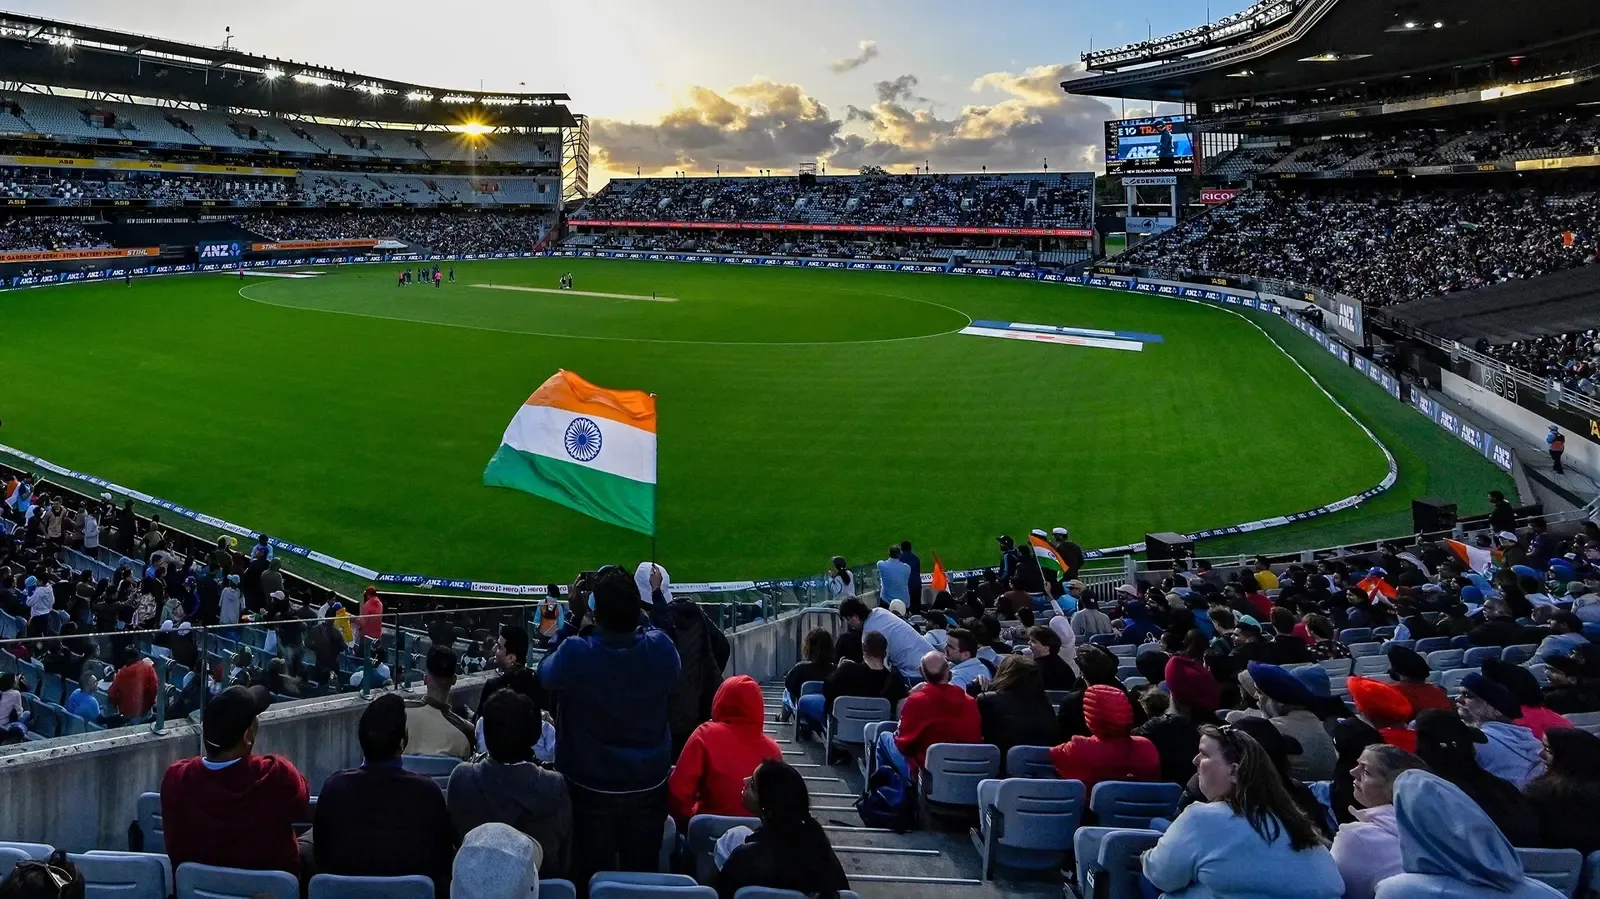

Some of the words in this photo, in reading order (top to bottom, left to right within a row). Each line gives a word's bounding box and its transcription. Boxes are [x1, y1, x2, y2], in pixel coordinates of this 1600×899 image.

[1124, 127, 1136, 135] 10
[1140, 124, 1172, 134] TRAE
[1126, 146, 1158, 159] ANZ
[201, 245, 228, 258] ANZ
[20, 276, 33, 284] ANZ
[1136, 283, 1150, 291] ANZ
[1159, 286, 1172, 294] ANZ
[1339, 303, 1354, 332] ANZ
[1440, 411, 1453, 432] ANZ
[1461, 424, 1476, 446] ANZ
[1493, 444, 1511, 470] ANZ
[106, 504, 113, 516] 2
